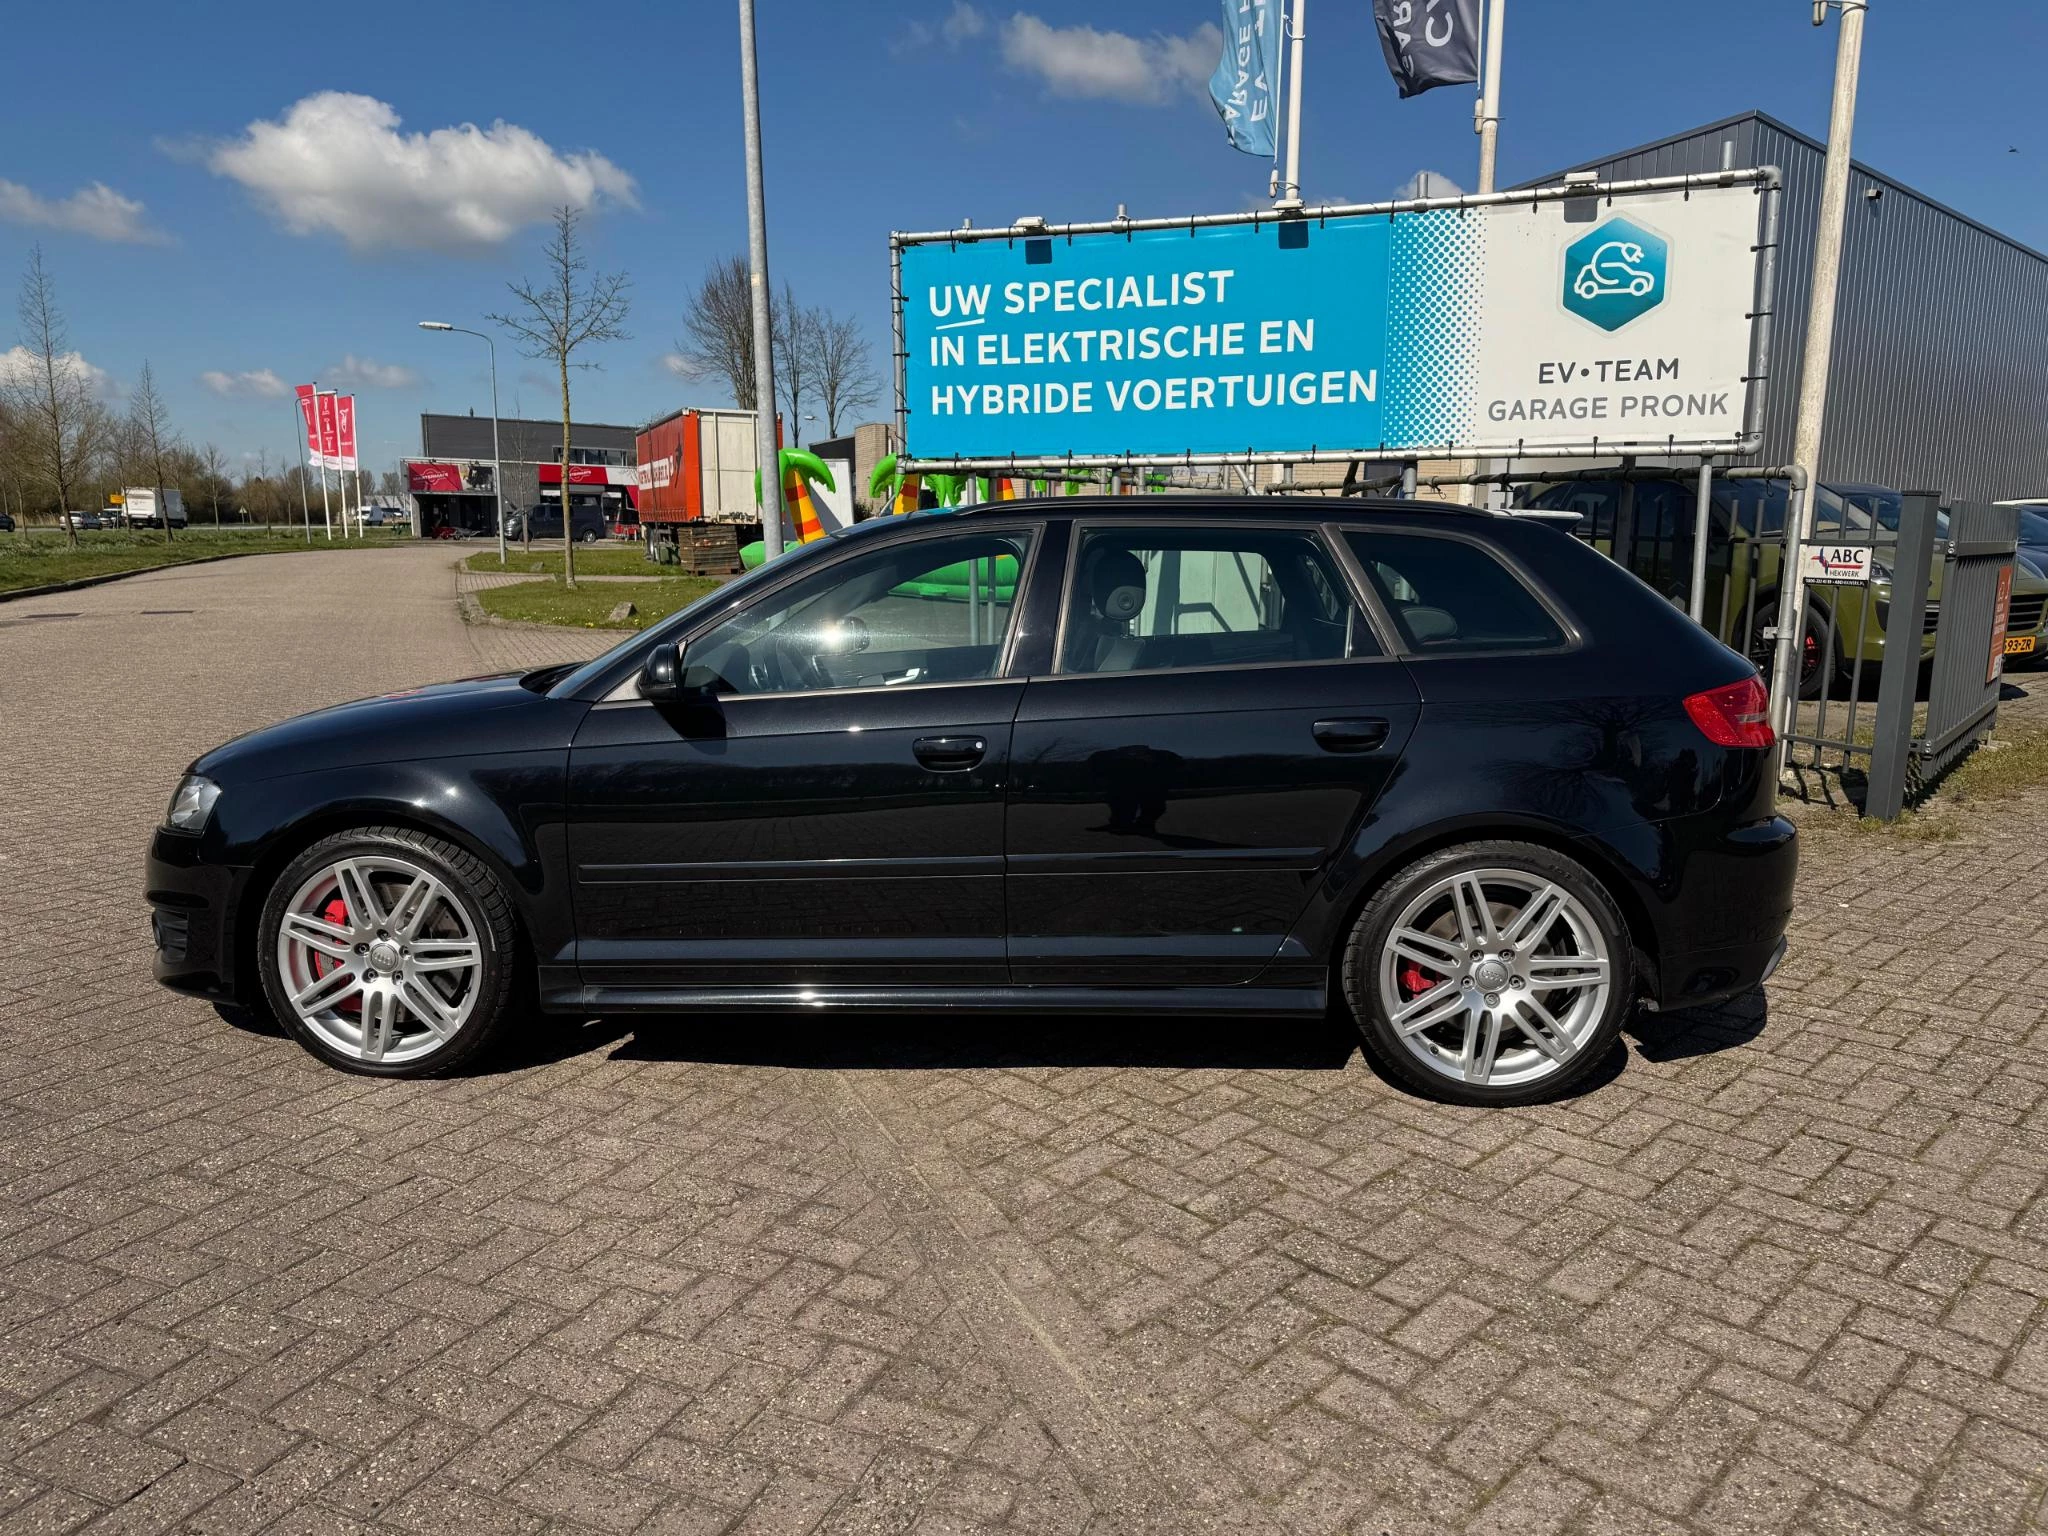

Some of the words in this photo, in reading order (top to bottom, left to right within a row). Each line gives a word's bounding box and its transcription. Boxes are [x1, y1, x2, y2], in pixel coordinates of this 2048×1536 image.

[929, 284, 992, 317] UW
[1004, 269, 1235, 315] SPECIALIST
[930, 335, 965, 367] IN
[977, 322, 1245, 366] ELEKTRISCHE
[1259, 318, 1314, 354] EN
[931, 382, 1093, 416] HYBRIDE
[1105, 369, 1377, 413] VOERTUIGEN
[1487, 396, 1609, 422] GARAGE
[1620, 392, 1729, 418] PRONK
[1829, 569, 1860, 577] HEKWERK
[1830, 548, 1864, 564] ABC
